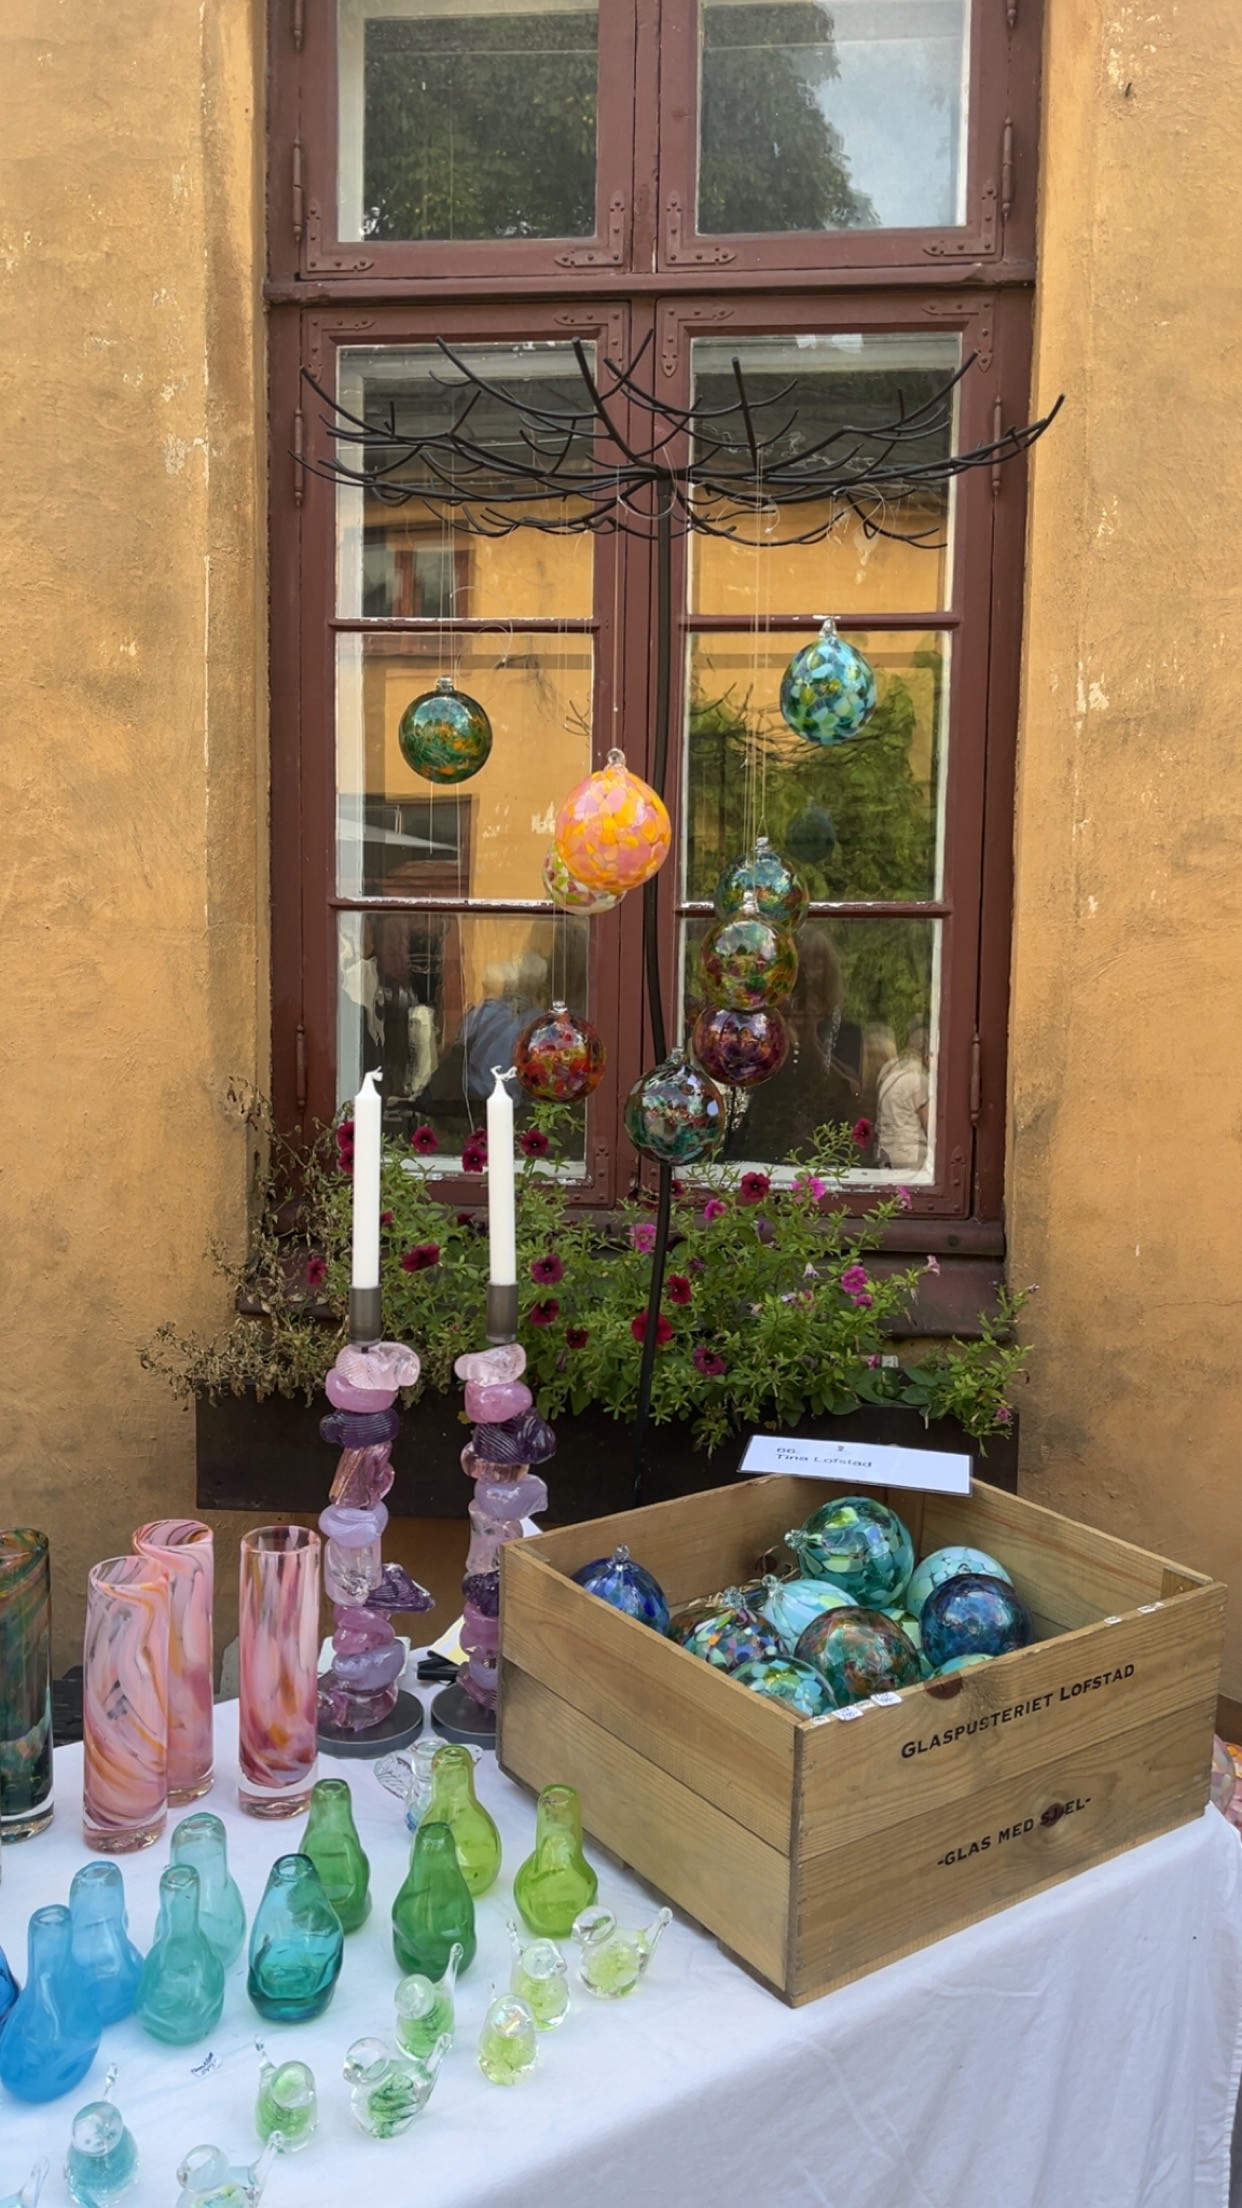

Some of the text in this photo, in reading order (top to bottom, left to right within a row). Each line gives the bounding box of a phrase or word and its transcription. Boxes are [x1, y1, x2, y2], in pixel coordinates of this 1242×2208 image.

[776, 1454, 808, 1462] Tina
[901, 1664, 1134, 1758] GLASPUSTERIET LOFSTAD
[998, 1819, 1034, 1843] MED
